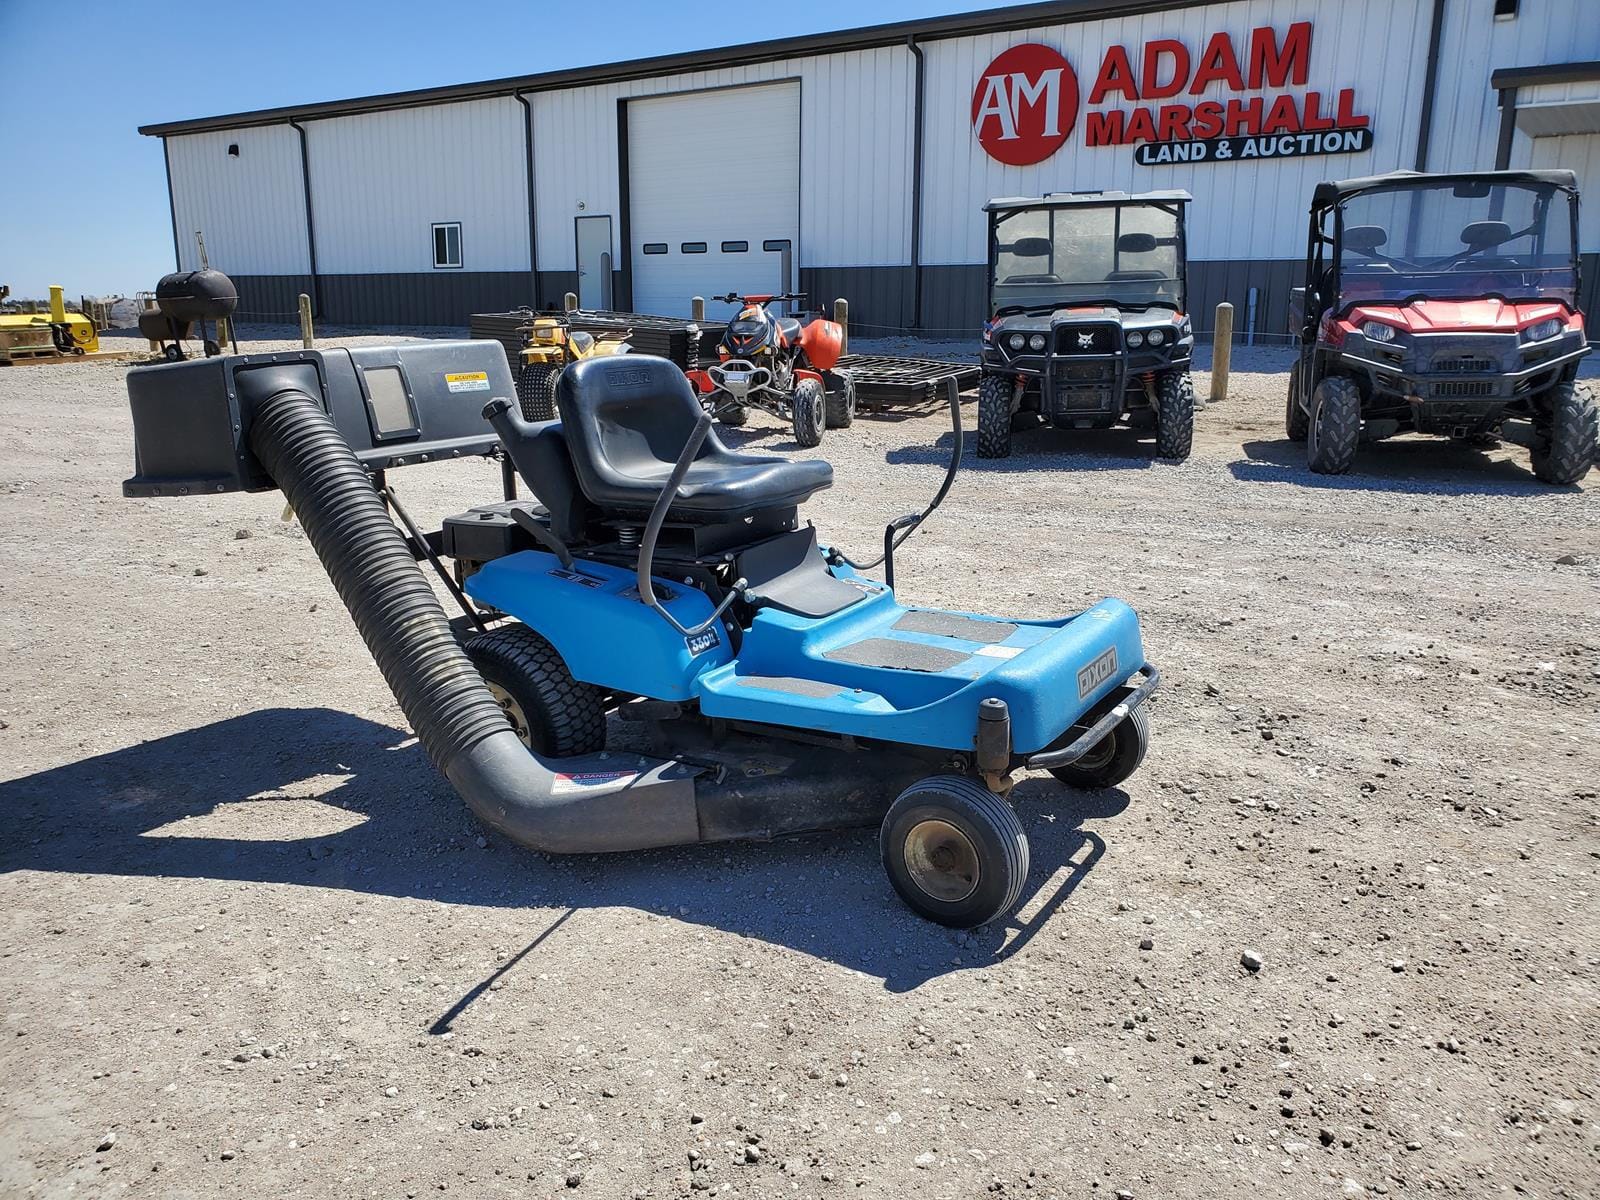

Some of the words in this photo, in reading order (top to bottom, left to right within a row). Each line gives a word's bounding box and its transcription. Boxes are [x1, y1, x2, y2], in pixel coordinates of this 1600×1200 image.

[1088, 22, 1312, 104] ADAM
[979, 68, 1064, 142] AM
[1086, 89, 1369, 147] MARSHALL
[1142, 143, 1207, 164] LAND
[1215, 141, 1233, 158] &
[1241, 130, 1363, 157] AUCTION
